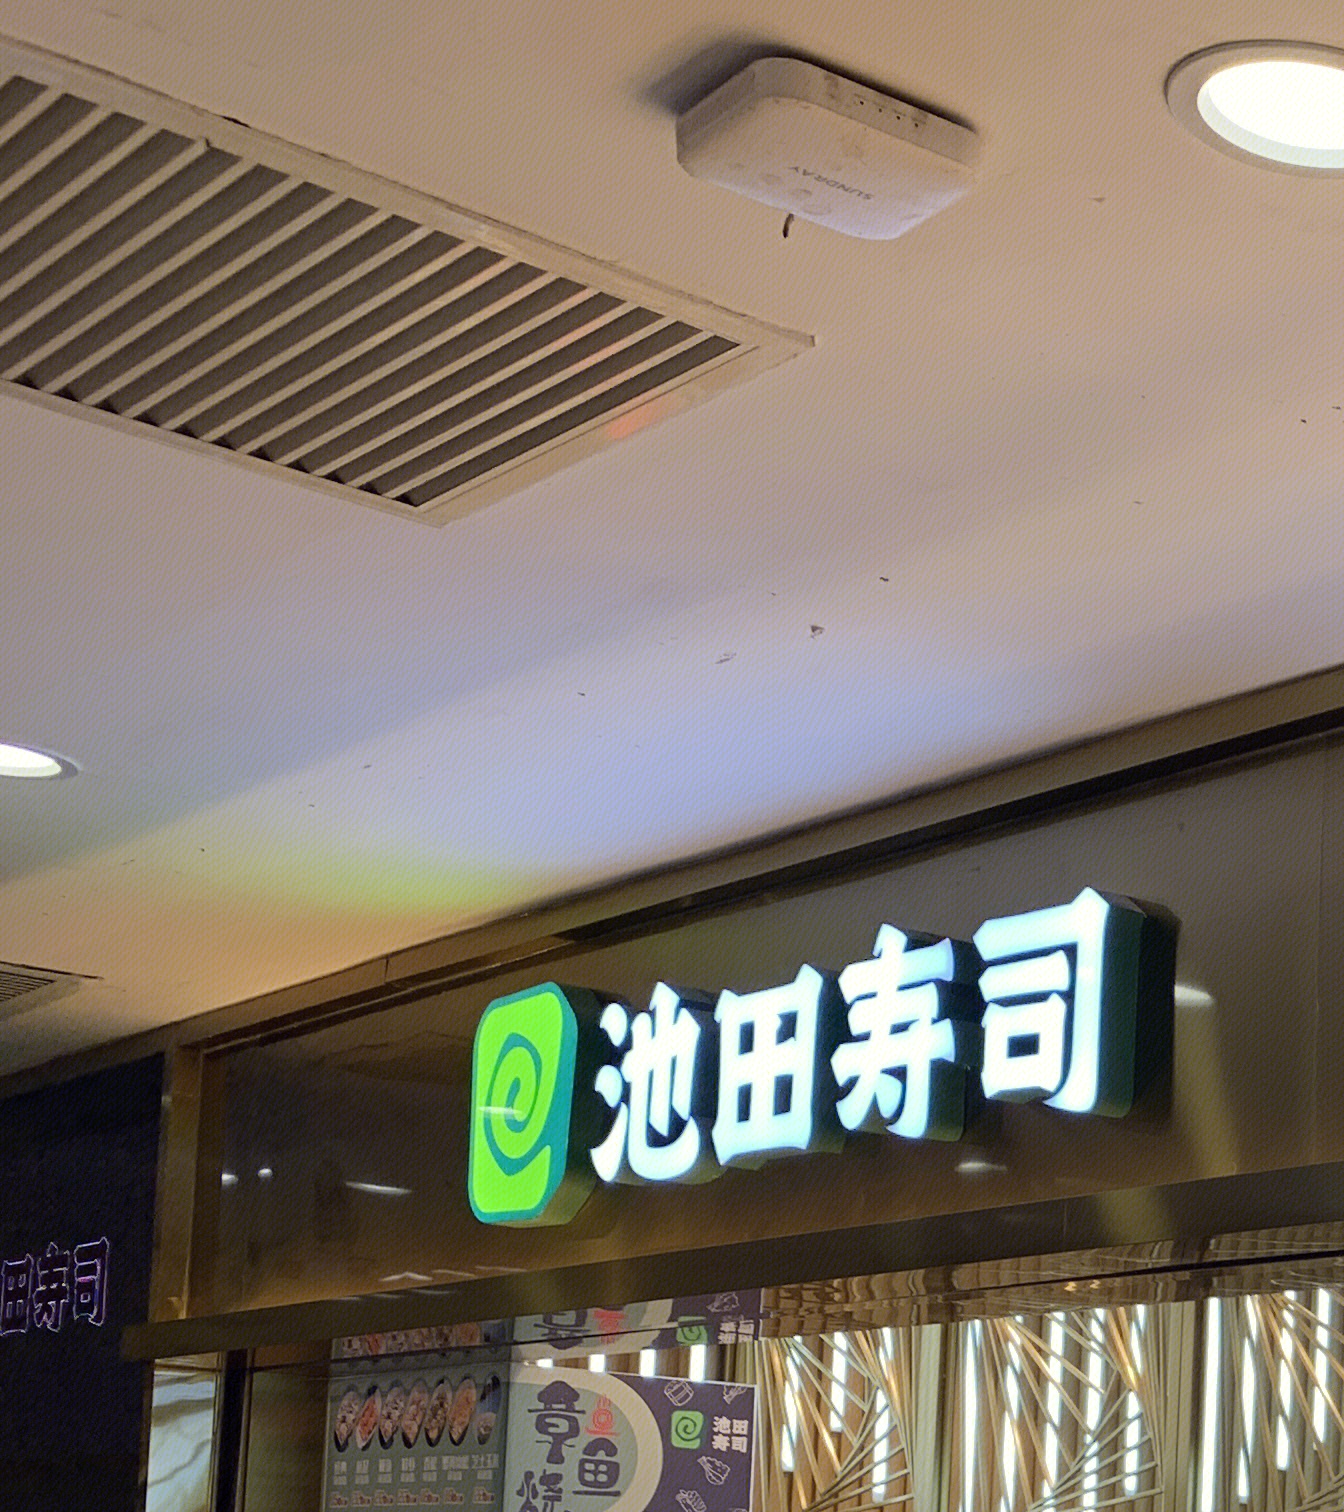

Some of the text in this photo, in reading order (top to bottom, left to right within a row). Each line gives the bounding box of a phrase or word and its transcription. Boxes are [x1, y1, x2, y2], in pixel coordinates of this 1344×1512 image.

[788, 165, 875, 200] SUNDRAY
[590, 886, 1111, 1182] 池田寿司
